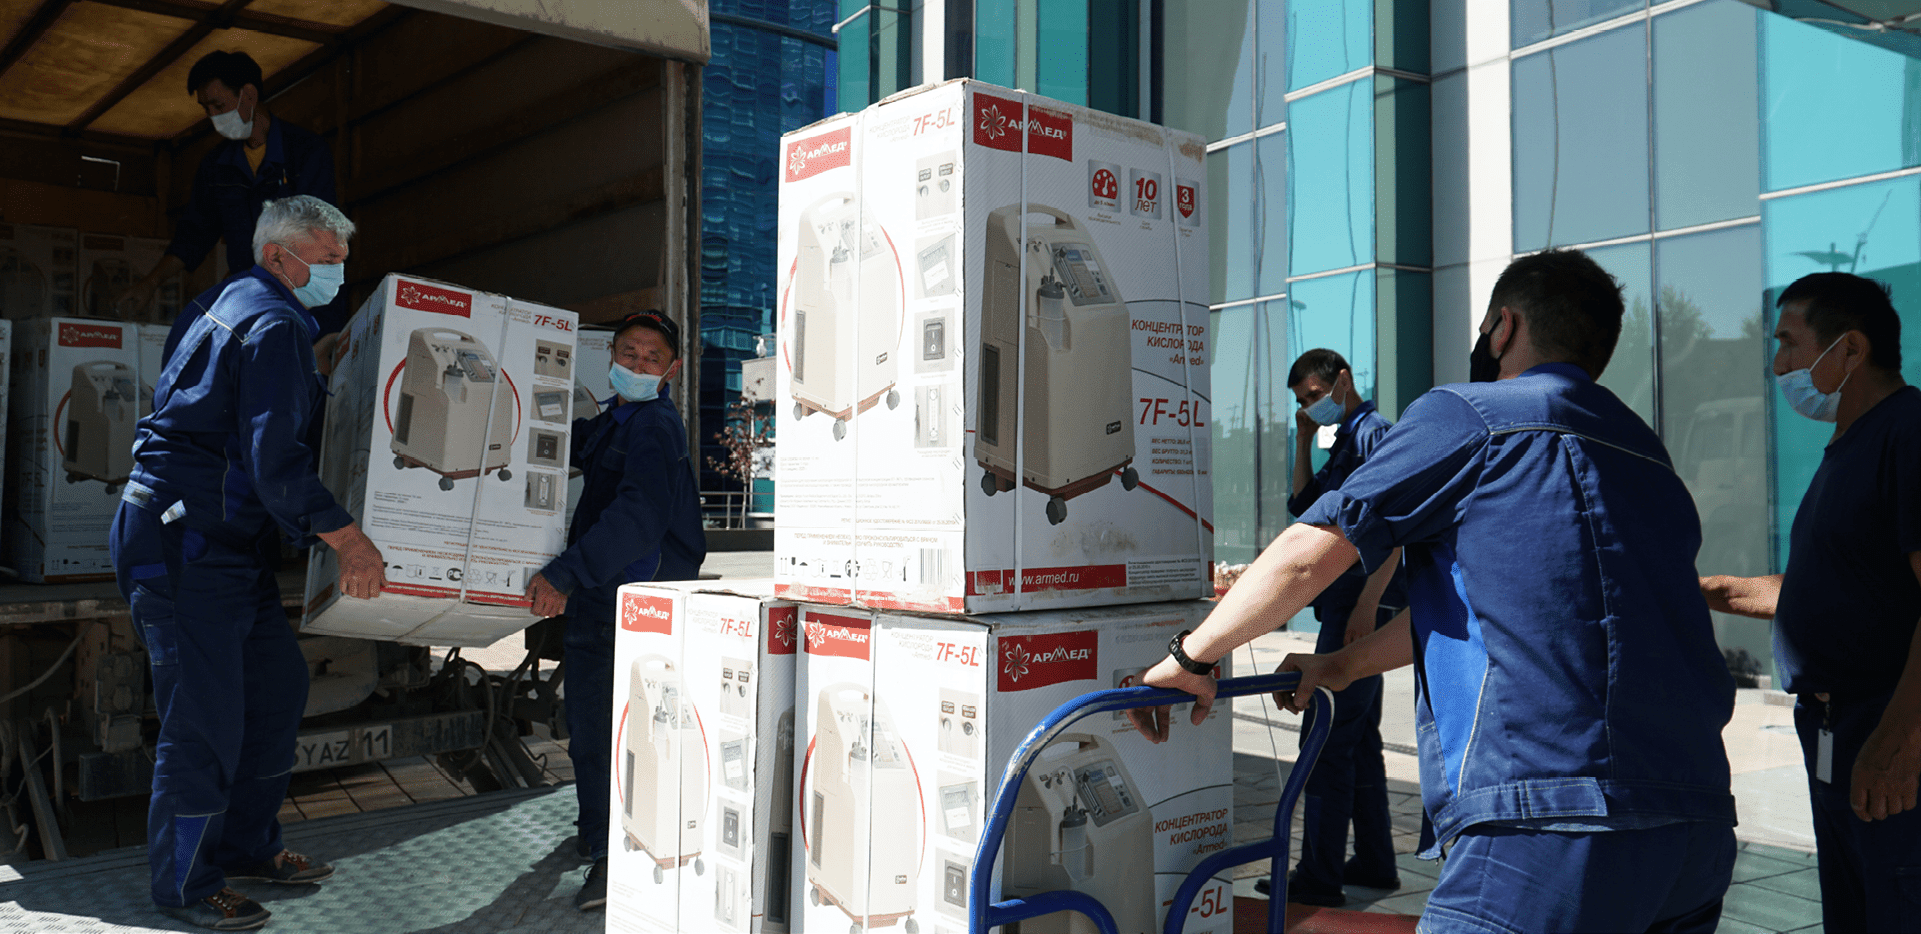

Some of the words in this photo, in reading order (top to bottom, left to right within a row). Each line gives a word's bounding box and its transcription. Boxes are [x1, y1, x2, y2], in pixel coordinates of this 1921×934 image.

[914, 108, 955, 136] 7F-5L
[1135, 177, 1157, 200] 10
[1181, 188, 1190, 202] 3
[1134, 198, 1157, 214] лет
[534, 314, 573, 332] 7F-5L
[1132, 319, 1205, 336] КОНЦЕНТРТОР
[1139, 398, 1205, 427] 7F-5L
[720, 617, 753, 638] 7F-5L
[826, 627, 866, 643] АРМЕД
[937, 642, 979, 667] 7F-5L
[1032, 645, 1088, 663] АРМЕД
[362, 729, 389, 756] 11
[1155, 808, 1228, 834] КОНЦЕНТРАТОР
[1169, 824, 1228, 846] КИСЛОРОДА
